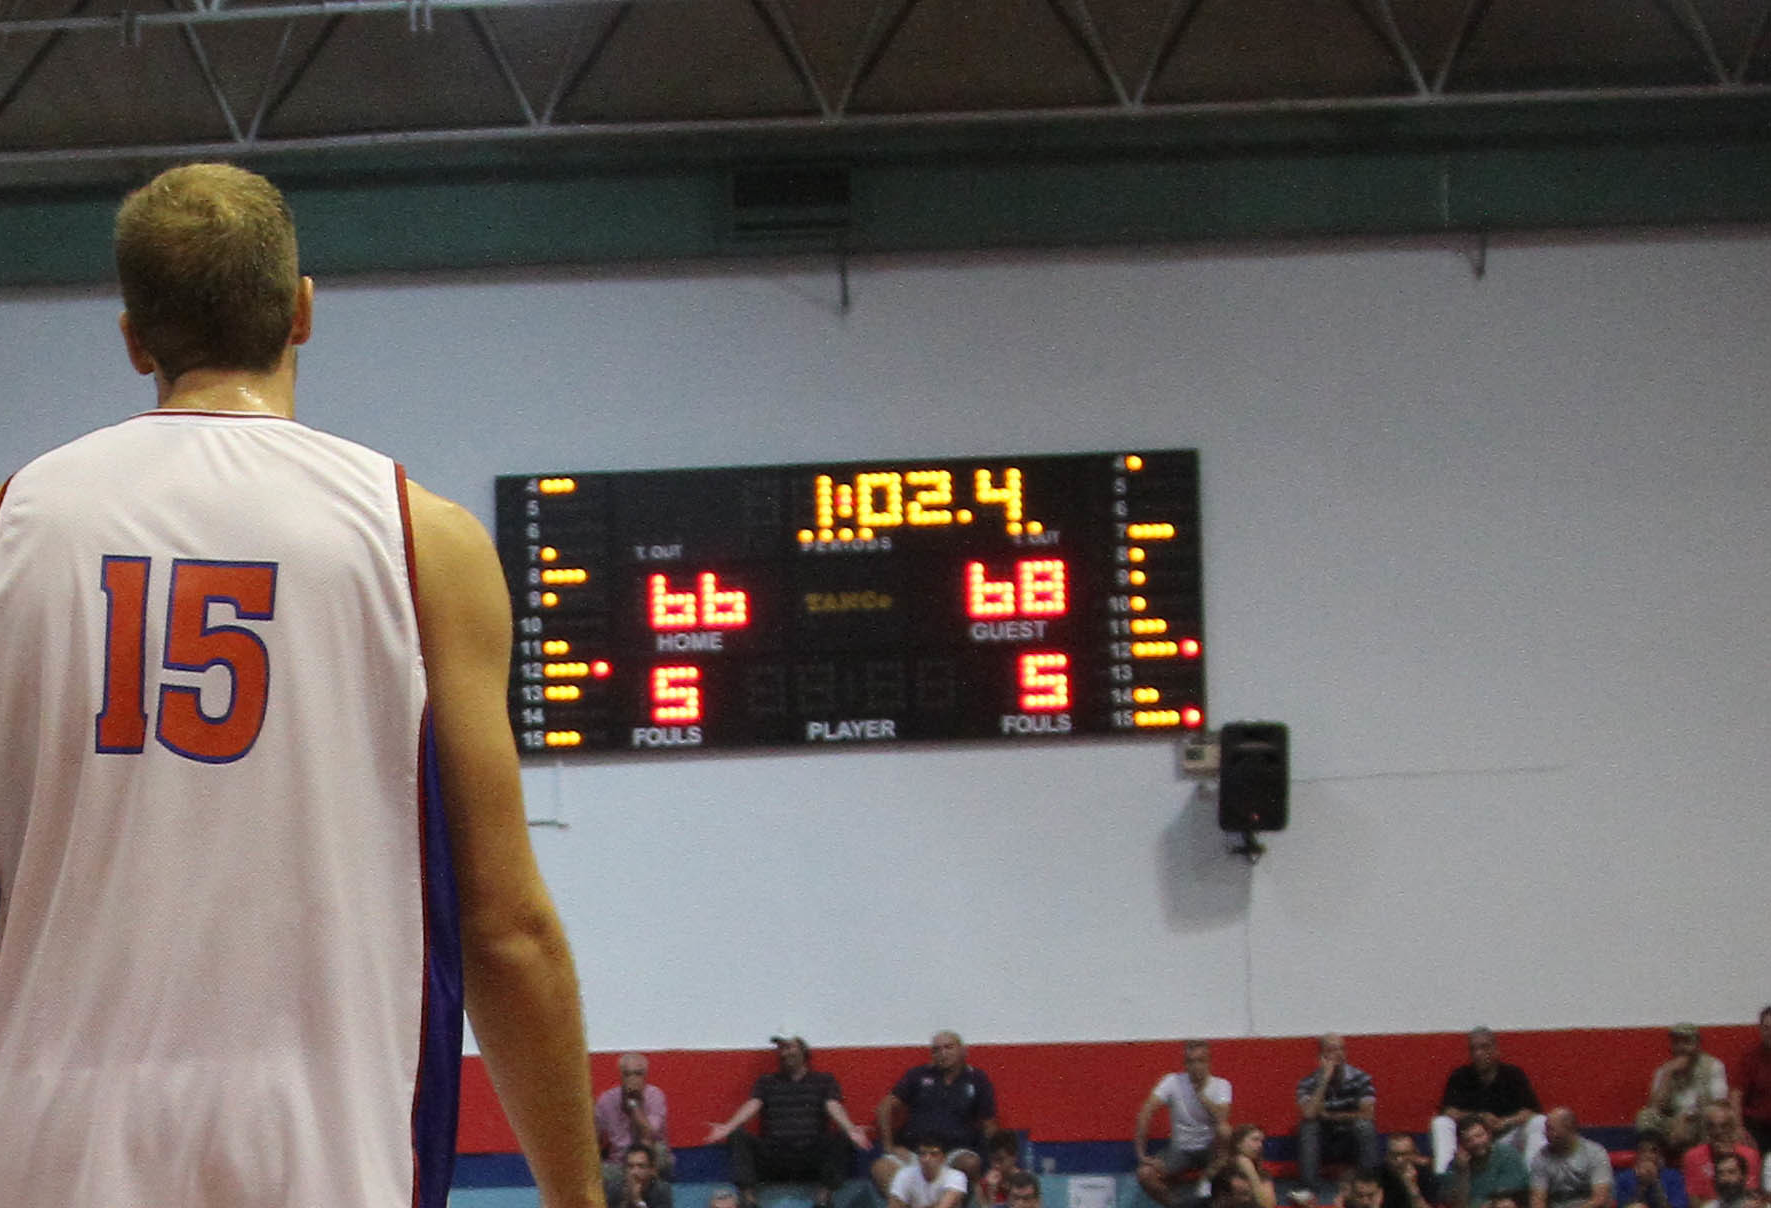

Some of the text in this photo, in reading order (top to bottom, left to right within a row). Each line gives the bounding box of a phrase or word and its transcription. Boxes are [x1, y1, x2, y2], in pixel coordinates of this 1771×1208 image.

[814, 467, 1024, 528] 1:02.4
[527, 500, 540, 516] 5
[527, 523, 540, 539] 6
[965, 559, 1066, 619] 68
[521, 617, 542, 634] 10
[972, 620, 1048, 642] GUEST
[521, 640, 542, 656] 11
[657, 632, 724, 651] HOME
[95, 555, 279, 764] 15
[521, 662, 543, 679] 12
[1112, 664, 1132, 681] 13
[1019, 655, 1067, 709] 5
[522, 684, 543, 701] 13
[651, 665, 700, 723] 5
[522, 707, 544, 724] 14
[1002, 715, 1071, 734] FOULS
[522, 730, 545, 747] 15
[632, 727, 703, 746] FOULS
[807, 721, 896, 740] PLAYER
